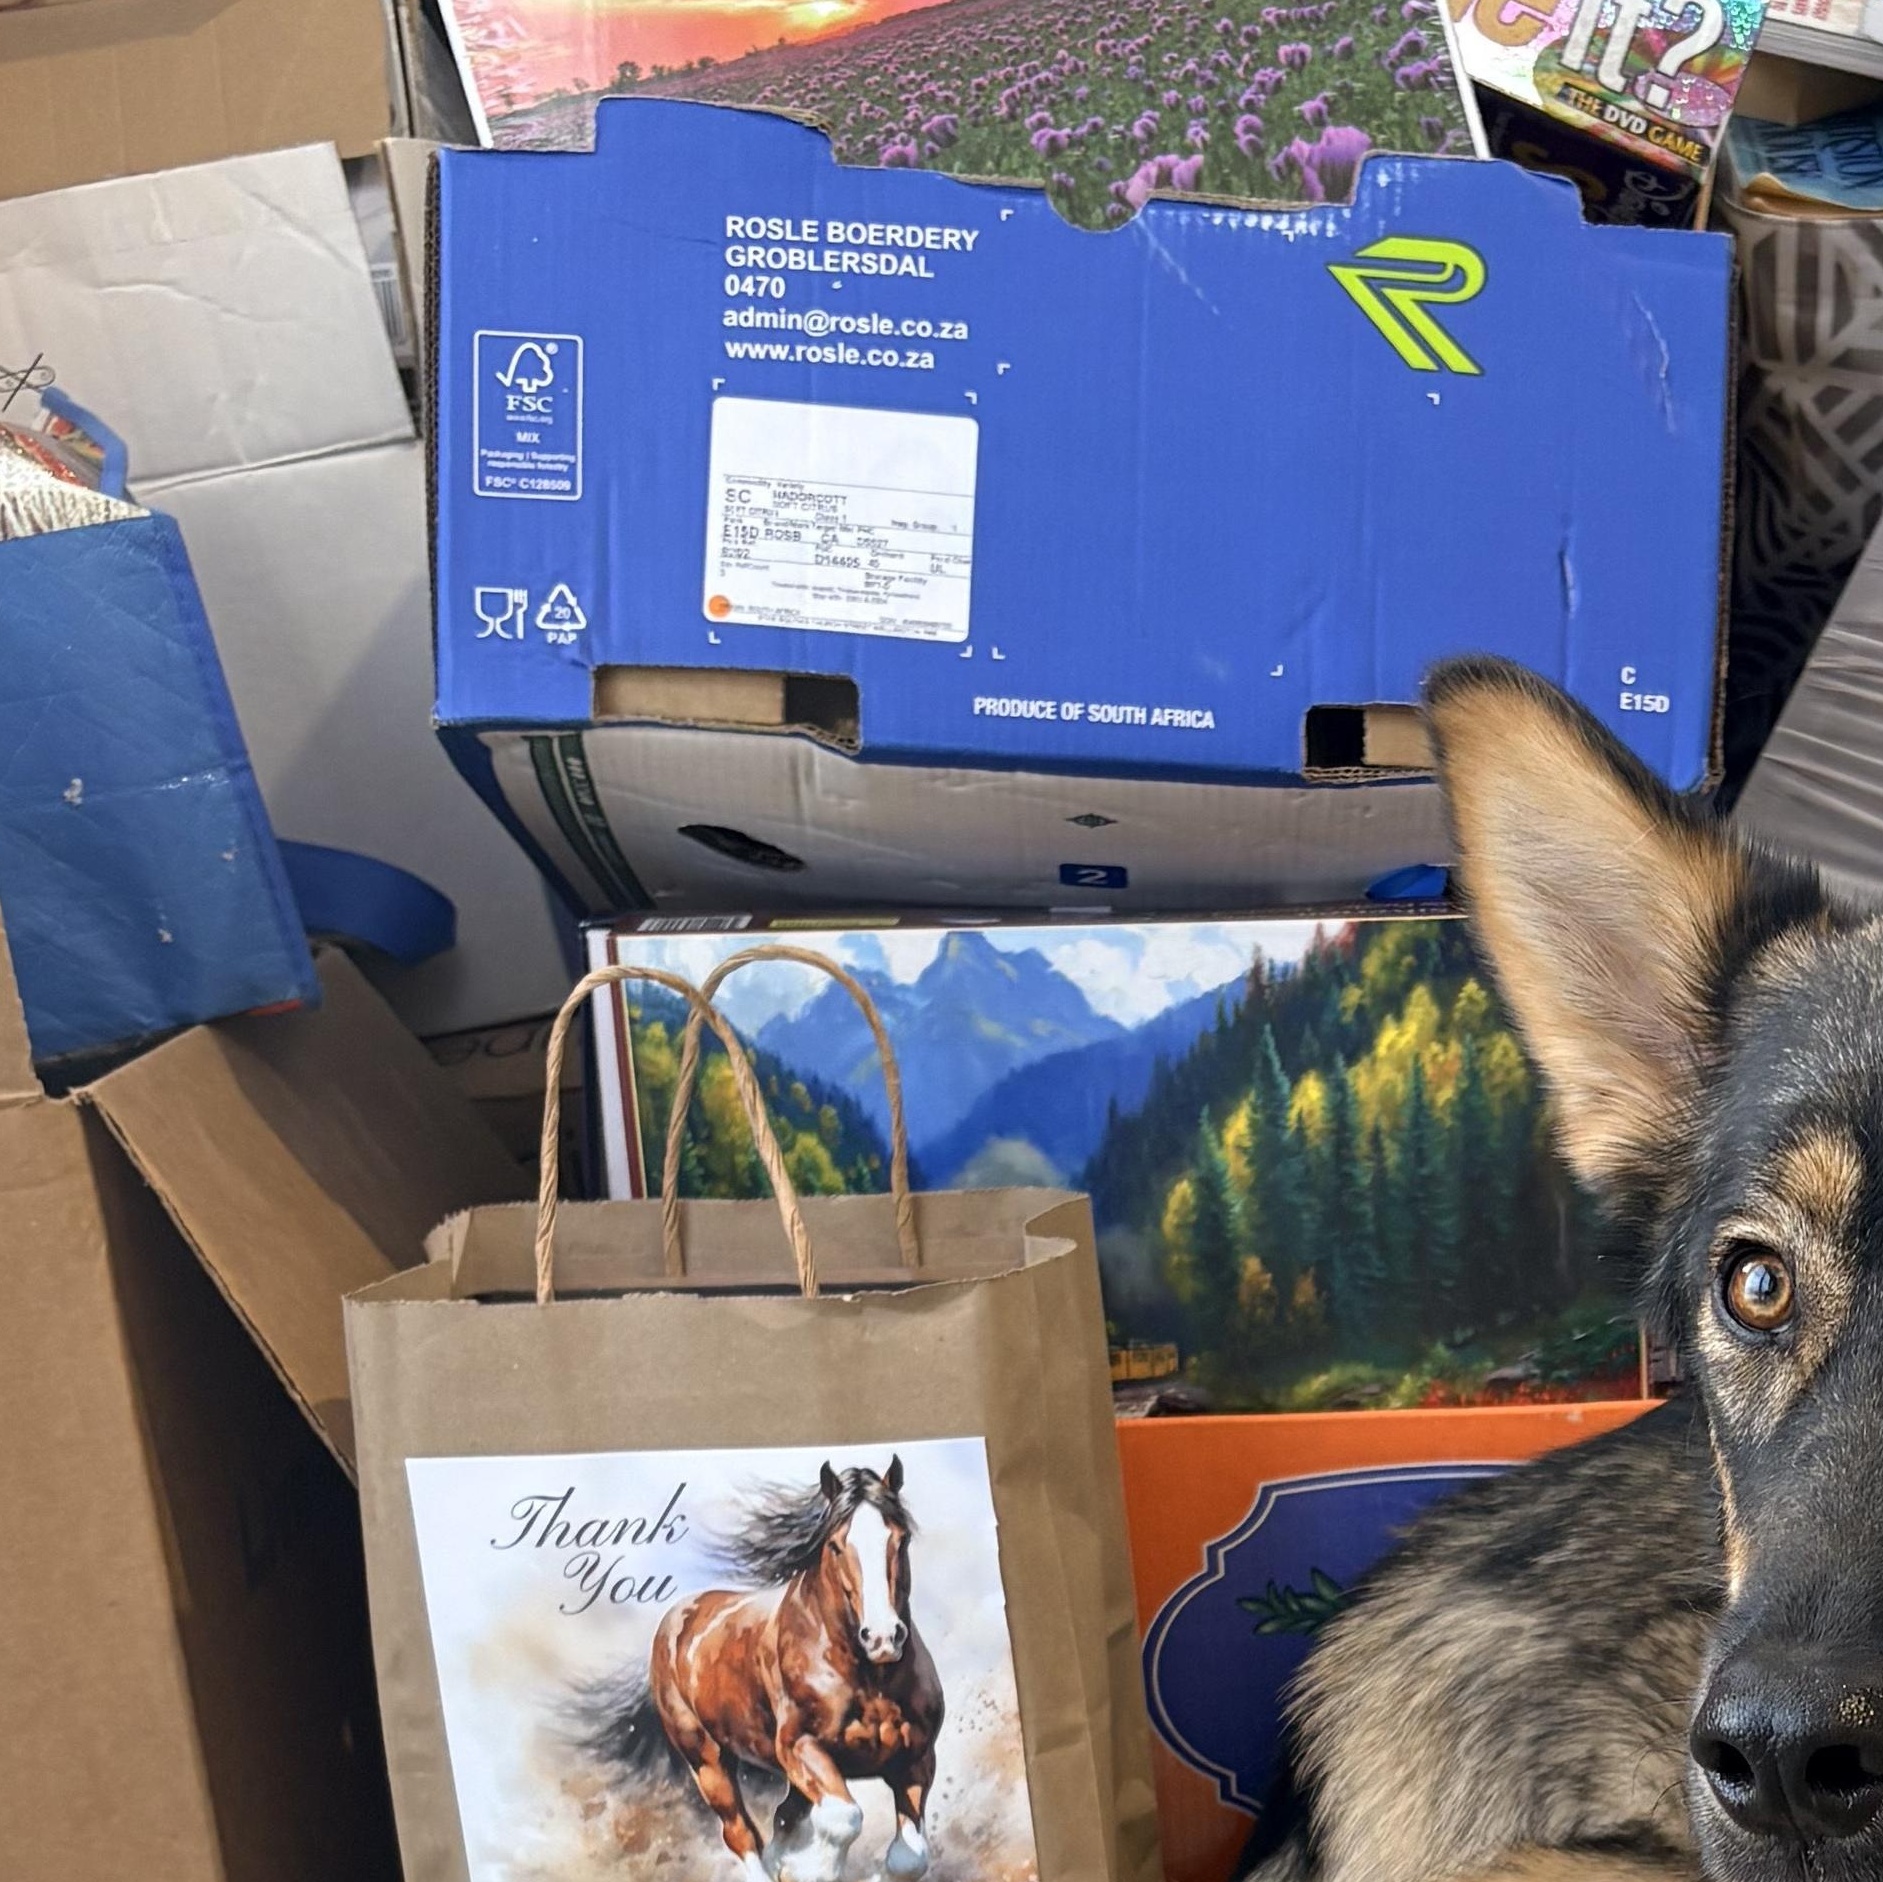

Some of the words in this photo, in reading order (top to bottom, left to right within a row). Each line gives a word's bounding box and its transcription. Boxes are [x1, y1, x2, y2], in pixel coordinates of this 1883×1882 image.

[1569, 88, 1602, 120] THE
[1603, 105, 1647, 134] DVD
[1647, 126, 1704, 162] GAME
[726, 215, 819, 243] ROSLE
[826, 221, 979, 251] BOERDERY
[725, 244, 935, 278] GROBLERSDAL
[724, 274, 786, 298] 0470
[722, 306, 969, 340] admin@rosle.co.za
[724, 341, 935, 369] www.rosle.co.za
[506, 394, 553, 412] FSC
[516, 431, 540, 443] MIX
[725, 488, 751, 503] SC
[554, 605, 571, 619] 20
[546, 631, 577, 644] PAP
[1621, 665, 1636, 685] C
[973, 696, 1057, 720] PRODUCE
[1060, 701, 1084, 721] OF
[1087, 703, 1147, 725] SOUTH
[1150, 707, 1216, 729] AFRICA
[1620, 692, 1670, 713] E15D
[1077, 868, 1107, 885] 2
[490, 1481, 690, 1551] Thank
[558, 1550, 678, 1616] You
